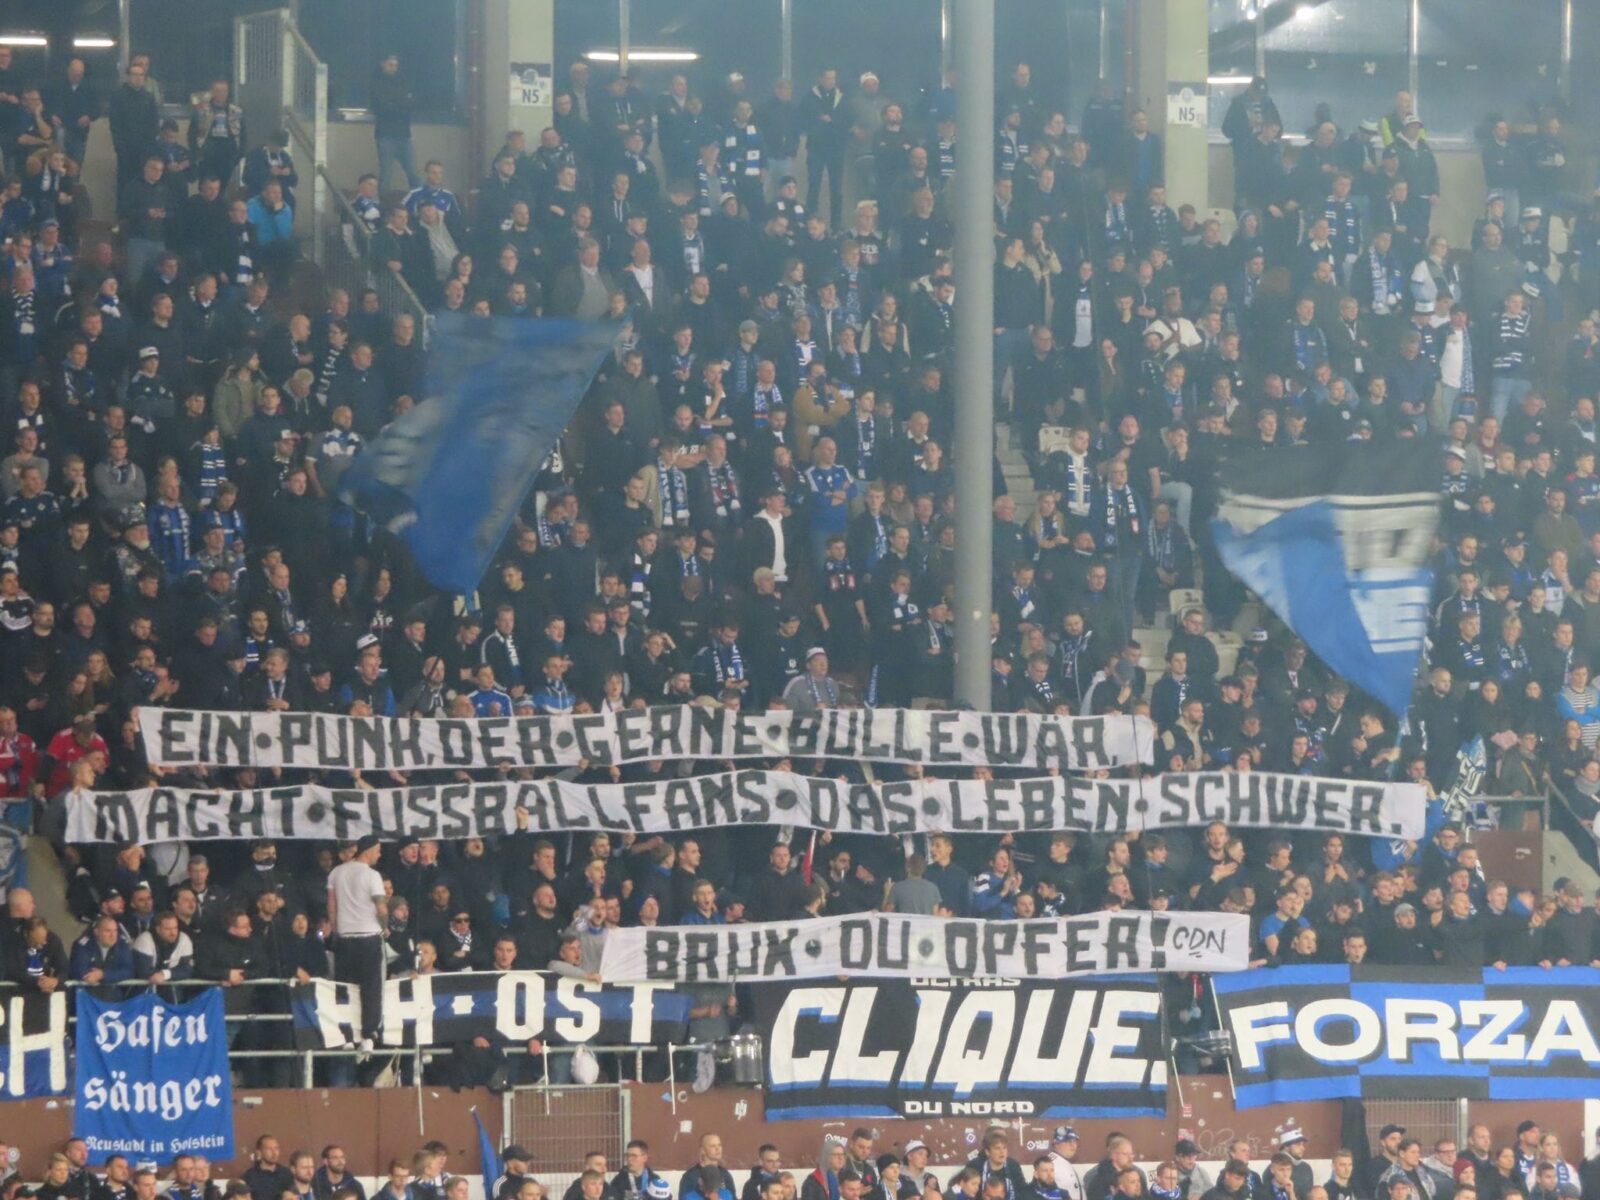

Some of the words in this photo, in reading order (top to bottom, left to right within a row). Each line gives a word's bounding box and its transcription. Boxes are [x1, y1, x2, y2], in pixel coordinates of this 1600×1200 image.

[522, 89, 539, 104] N5
[1179, 107, 1195, 121] N5
[159, 711, 251, 765] EIN
[438, 718, 556, 766] DER
[573, 704, 767, 767] GERNE
[787, 708, 962, 762] BULLE
[95, 787, 303, 843] MACHT
[332, 770, 770, 840] FUSSBALLFANS
[806, 778, 916, 834] DAS
[949, 775, 1129, 831] LEBEN
[1160, 773, 1402, 836] SCHWER.
[645, 928, 798, 980] BRUX
[840, 918, 910, 969] DU
[945, 917, 1170, 976] OPFER!
[1173, 926, 1225, 957] CDN
[0, 991, 67, 1096] H
[95, 1005, 208, 1054] Hafen
[1229, 998, 1600, 1069] FORZA
[904, 1100, 942, 1114] DU
[950, 1100, 1034, 1115] NORD
[86, 1136, 146, 1152] Neustadt
[151, 1138, 164, 1152] in
[171, 1134, 225, 1153] Holstein
